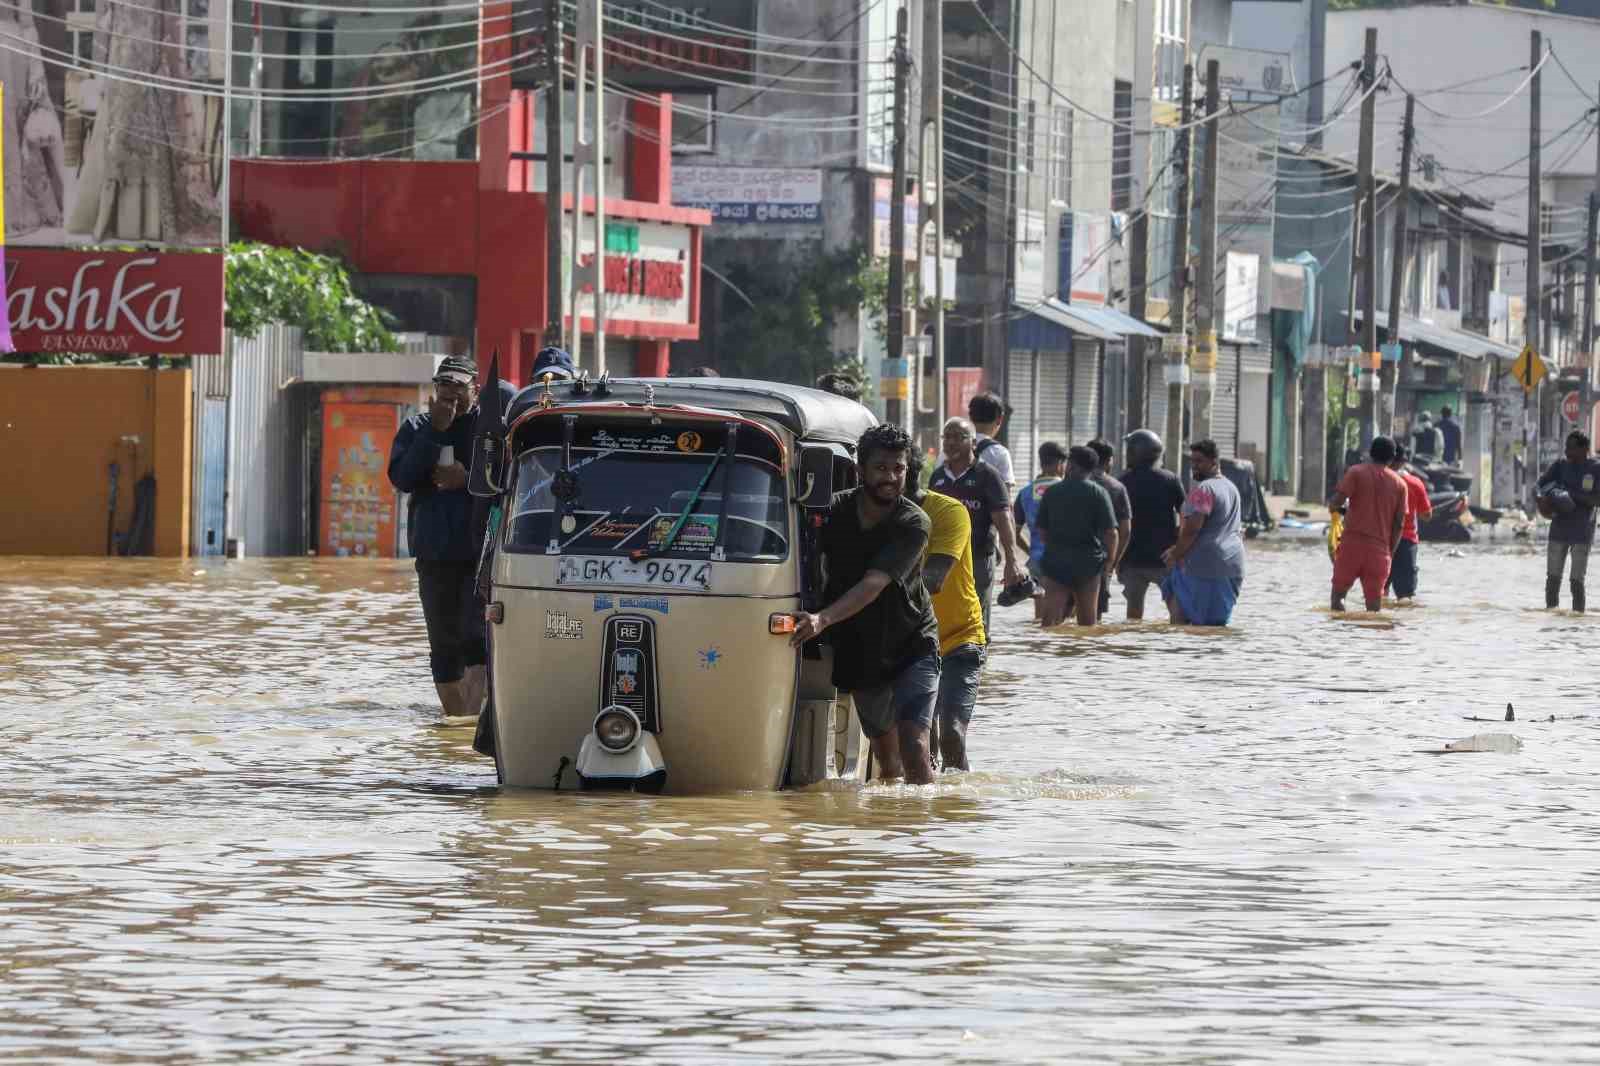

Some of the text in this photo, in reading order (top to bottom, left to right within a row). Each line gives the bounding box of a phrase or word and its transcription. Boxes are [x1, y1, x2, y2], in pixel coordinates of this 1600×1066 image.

[584, 559, 615, 580] GK
[646, 562, 708, 585] 9674
[620, 627, 638, 638] RE
